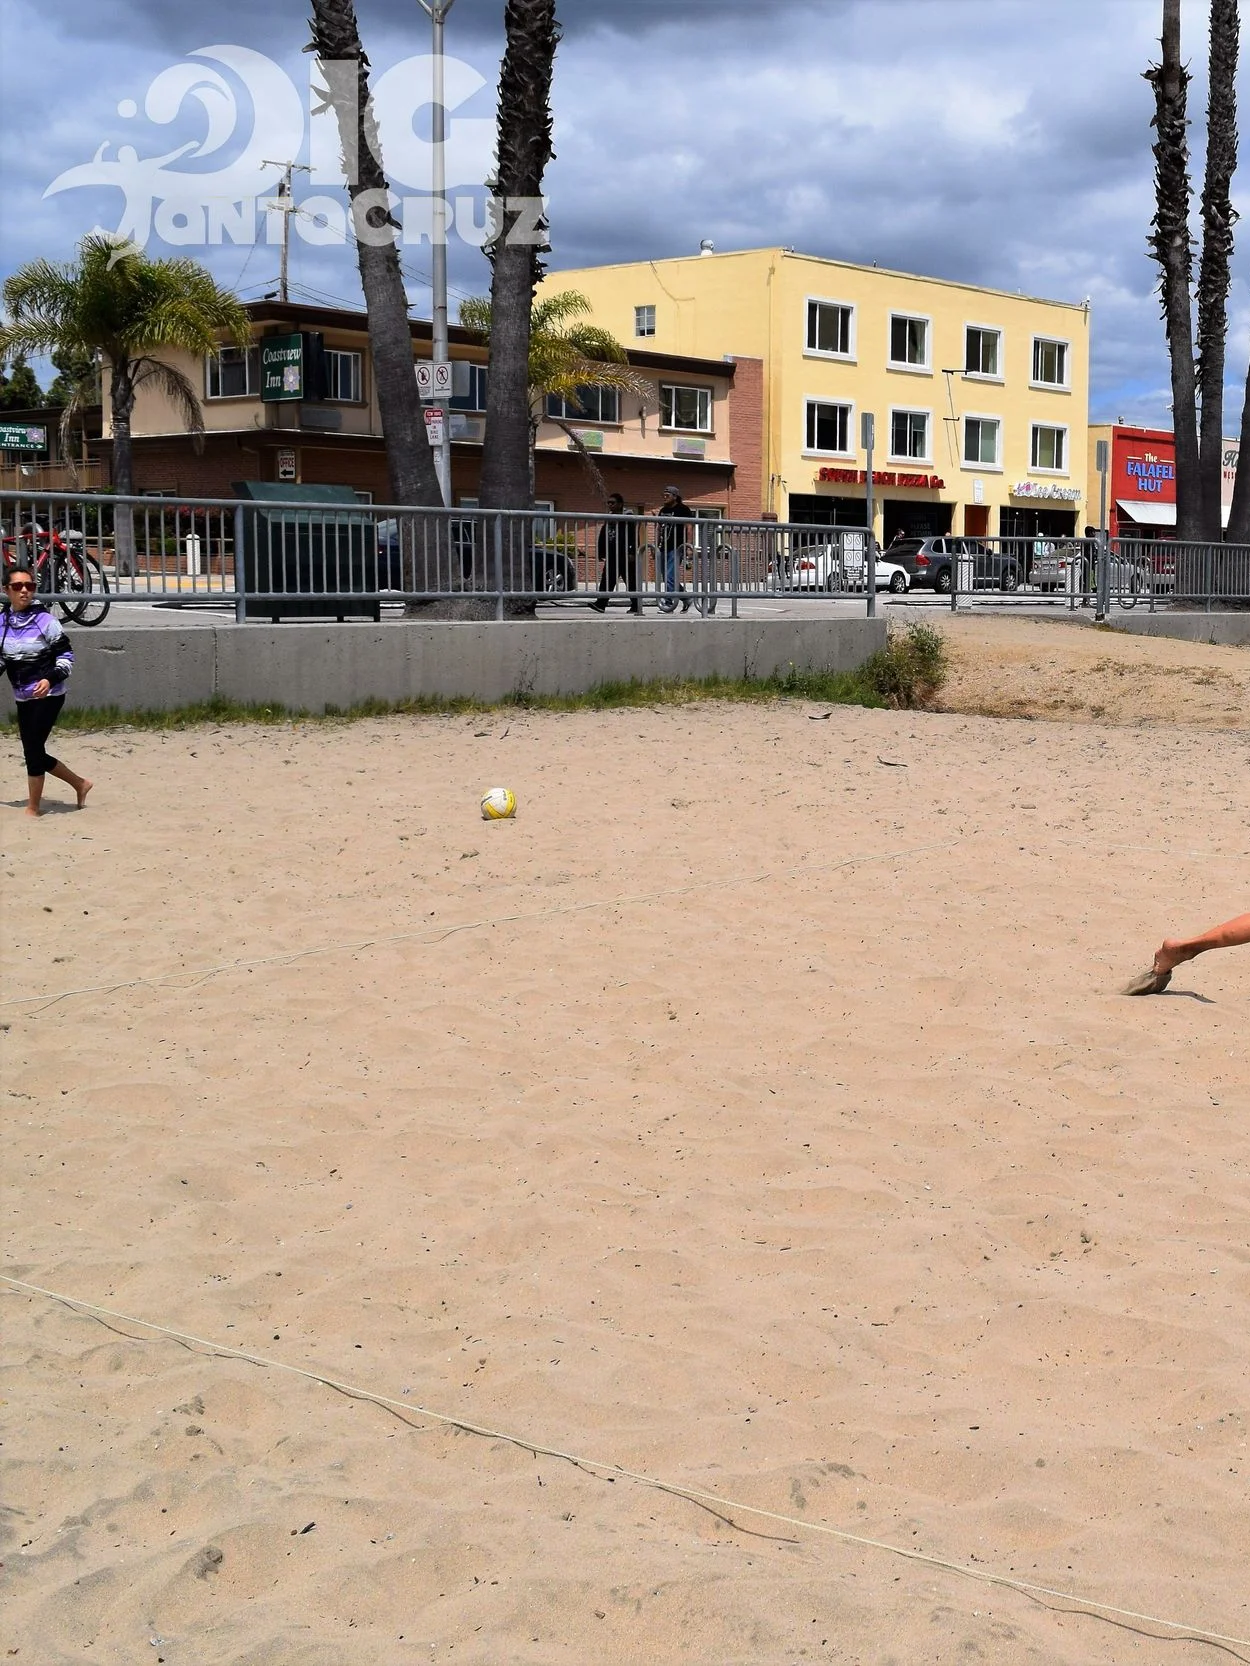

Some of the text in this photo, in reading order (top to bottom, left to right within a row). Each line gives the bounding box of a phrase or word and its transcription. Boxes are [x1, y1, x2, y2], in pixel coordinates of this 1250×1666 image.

[263, 348, 301, 364] Coastview
[266, 371, 281, 388] Inn
[0, 426, 27, 434] oastview
[4, 433, 19, 442] Inn
[1144, 452, 1158, 463] The
[1126, 461, 1175, 480] FALAFEL
[1137, 477, 1163, 492] HUT
